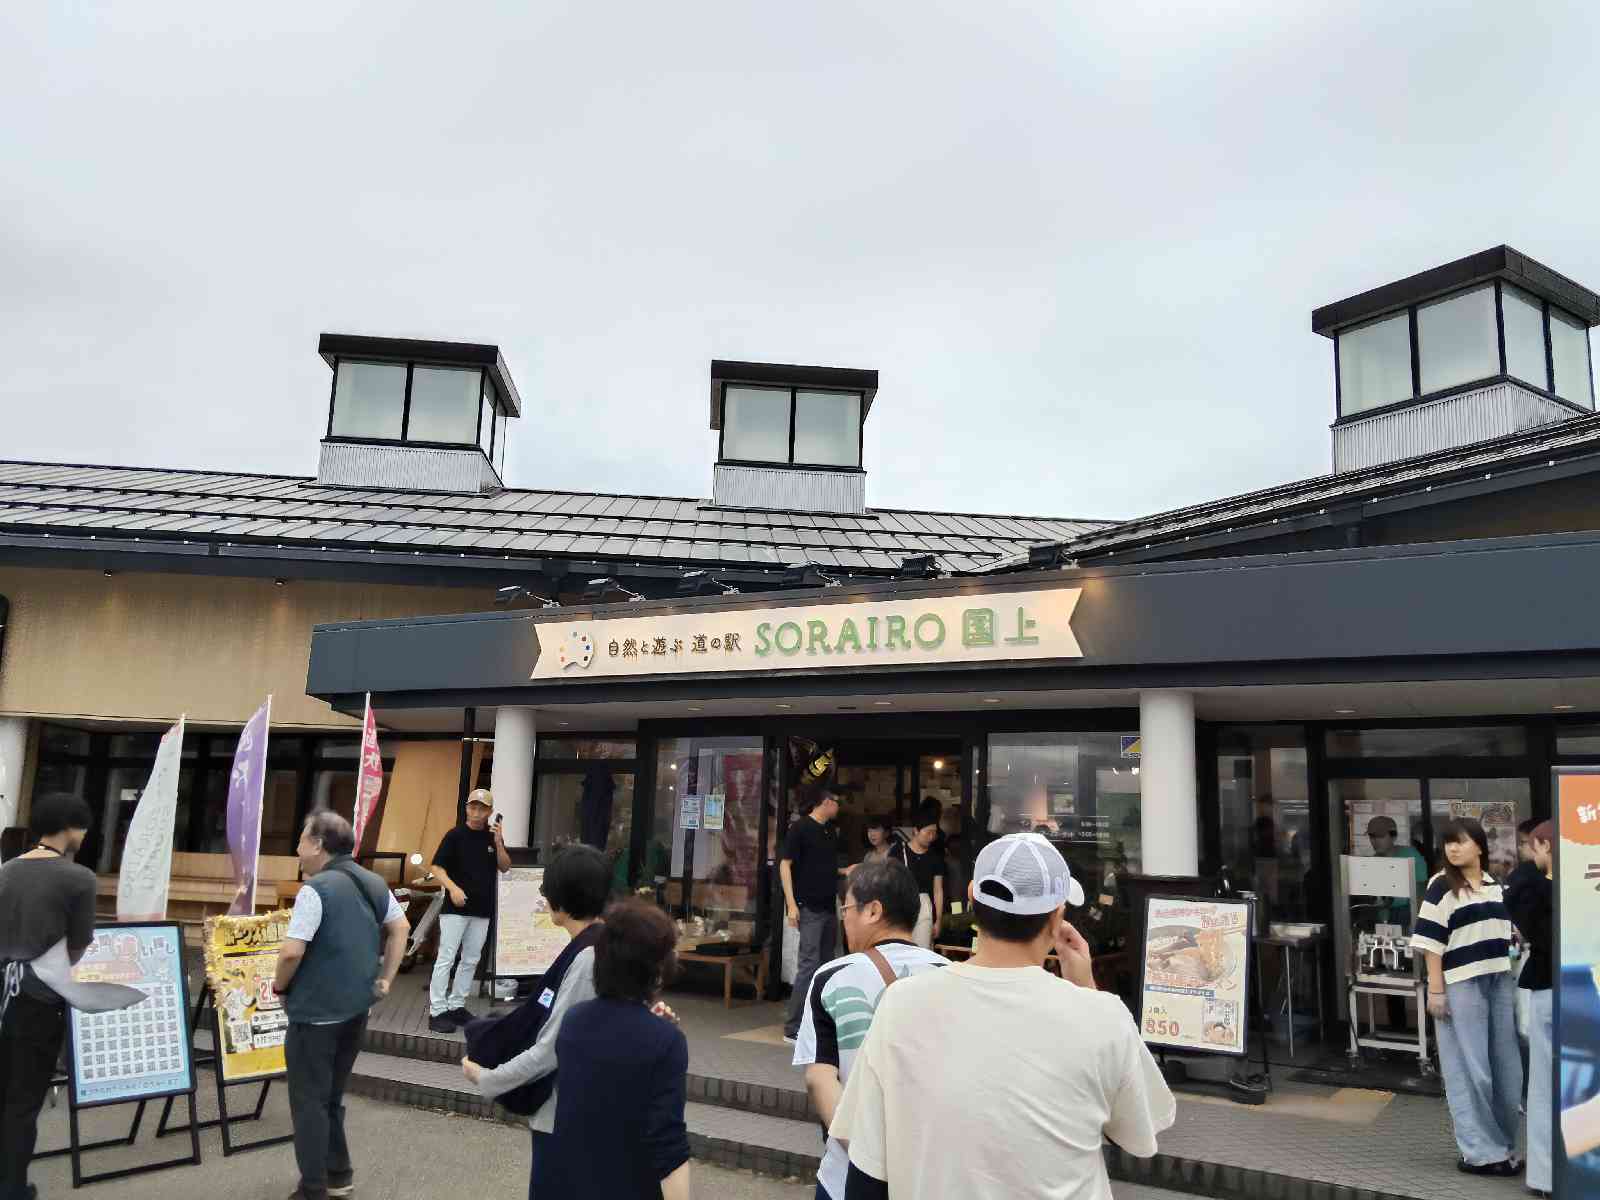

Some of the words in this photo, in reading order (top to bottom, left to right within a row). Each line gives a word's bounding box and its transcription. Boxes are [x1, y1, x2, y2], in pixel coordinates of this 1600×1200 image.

[608, 636, 683, 658] 自然と遊ぶ
[691, 632, 742, 653] 道の駅
[754, 612, 947, 657] SORAIRO
[961, 606, 1039, 648] 国上
[1576, 803, 1600, 824] 新
